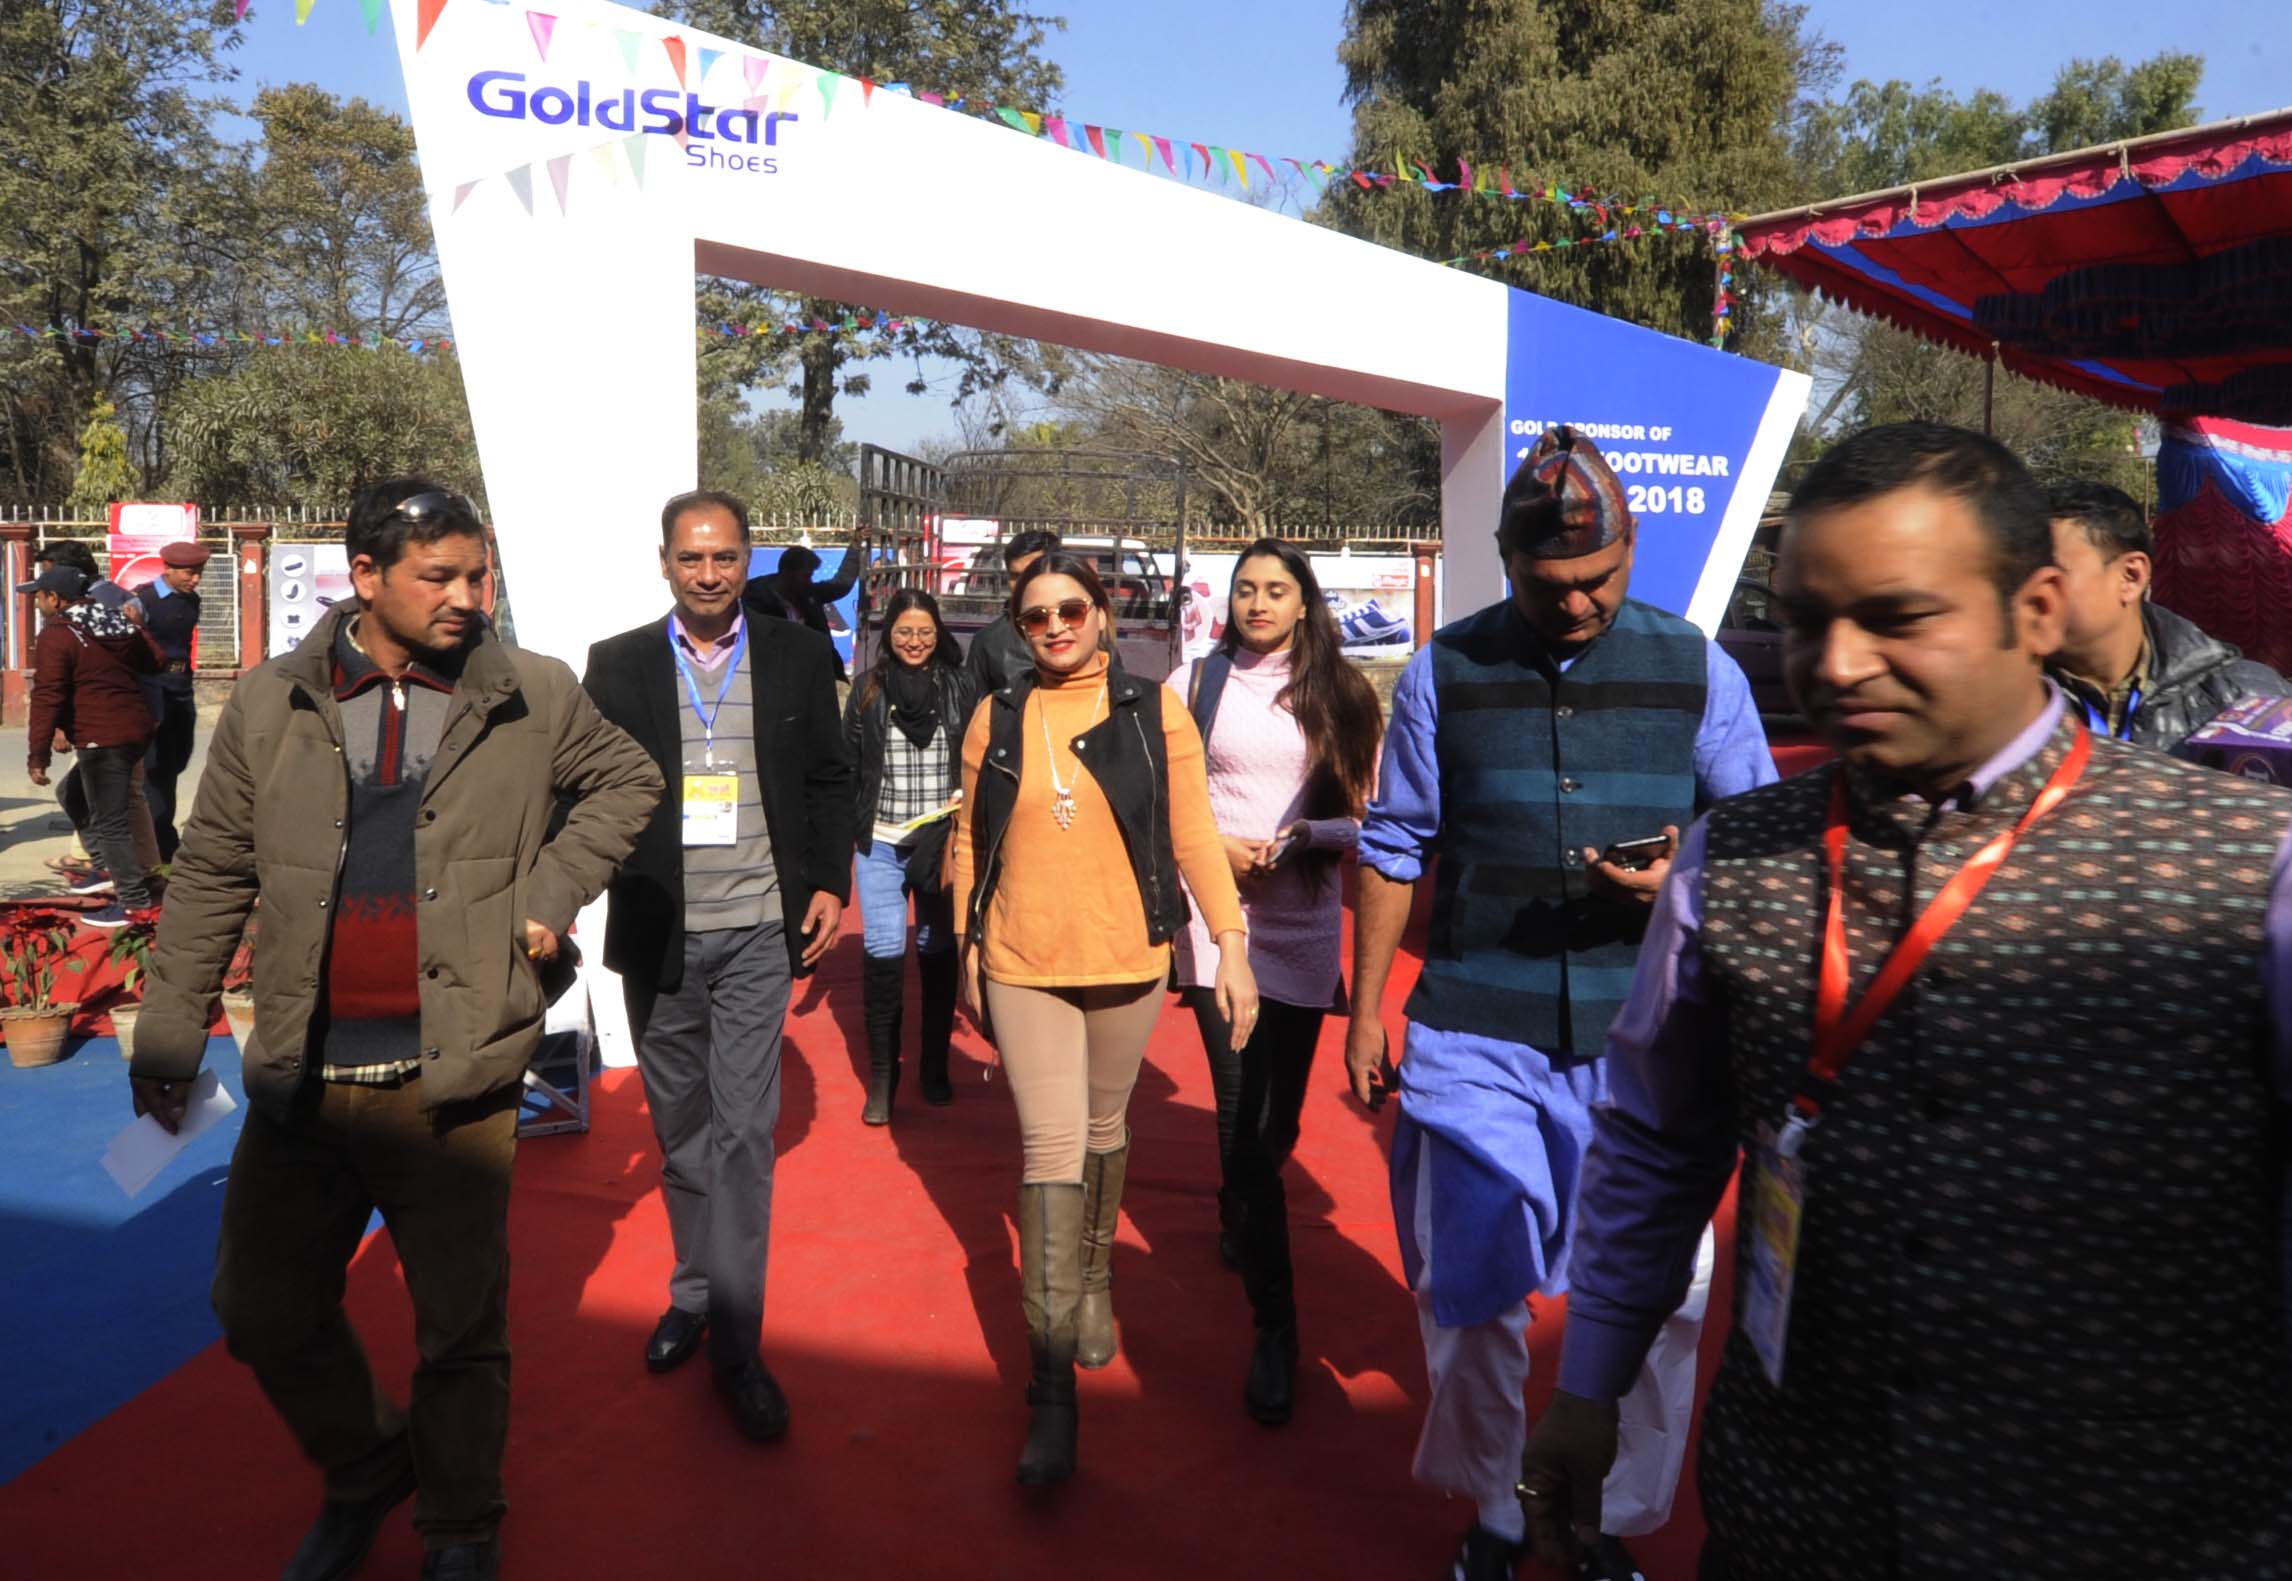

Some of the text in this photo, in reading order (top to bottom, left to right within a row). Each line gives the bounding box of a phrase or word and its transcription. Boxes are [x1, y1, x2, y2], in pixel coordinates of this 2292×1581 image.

[467, 70, 799, 146] GoldStar
[685, 144, 779, 174] Shoes
[1564, 422, 1645, 440] PONSOR
[1649, 426, 1672, 442] OF
[1600, 451, 1729, 476] OOTWEAR
[1627, 485, 1706, 514] 2018
